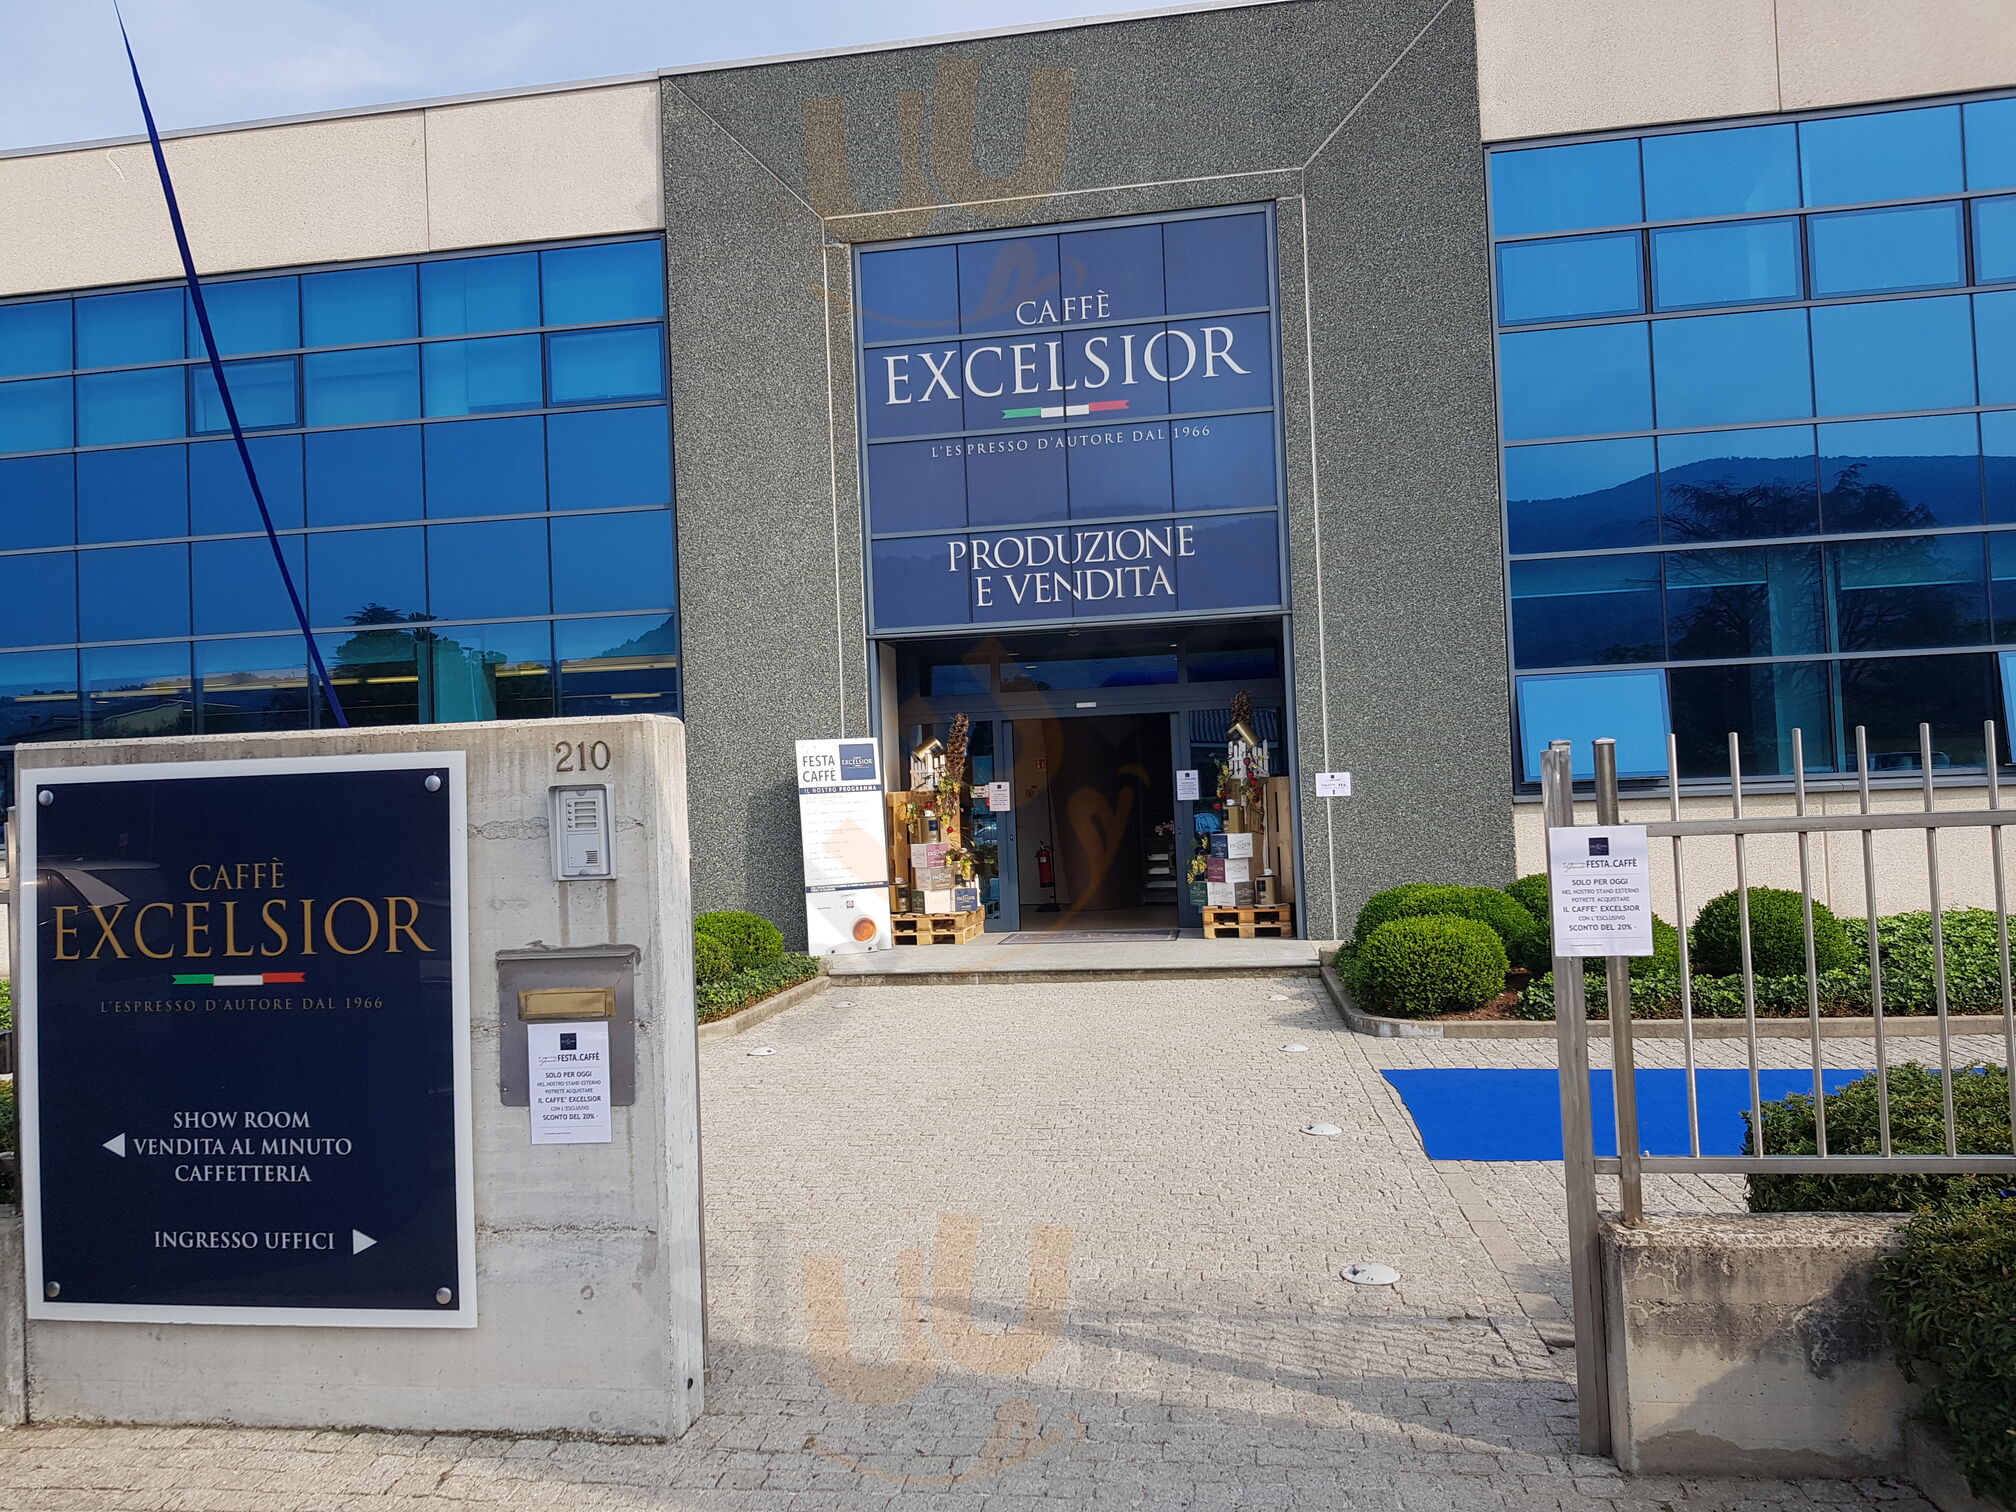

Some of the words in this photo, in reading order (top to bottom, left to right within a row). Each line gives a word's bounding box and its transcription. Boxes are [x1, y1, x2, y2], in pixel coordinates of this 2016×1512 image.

[1016, 290, 1111, 325] CAFFÈ
[882, 326, 1251, 405] EXCELSIOR
[931, 439, 1028, 458] L'ESPRESSO
[1038, 432, 1124, 449] D'AUTORE
[1133, 429, 1165, 442] DAL
[1173, 425, 1211, 439] 1966
[947, 525, 1196, 572] PRODUZIONE
[975, 576, 993, 607] E
[1003, 565, 1175, 605] VENDITA
[555, 740, 611, 772] 210
[802, 755, 835, 767] FESTA
[802, 768, 837, 782] CAFFÈ
[1586, 860, 1610, 869] FESTA
[1613, 857, 1638, 868] CAFFÈ
[189, 857, 285, 892] CAFFÈ
[52, 896, 436, 961] EXCELSIOR
[101, 1000, 197, 1014] L'ESPRESSO
[205, 998, 293, 1012] D'AUTORE
[302, 997, 336, 1011] DAL
[345, 997, 383, 1009] 1966
[557, 1054, 576, 1062] FESTA
[580, 1051, 600, 1061] CAFFÈ
[173, 1111, 238, 1129] SHOW
[244, 1111, 310, 1129] ROOM
[133, 1138, 225, 1155] VENDITA
[231, 1138, 255, 1155] AL
[261, 1138, 352, 1156] MINUTO
[175, 1165, 312, 1182] CAFFETTERIA
[154, 1231, 258, 1249] INGRESSO
[264, 1232, 335, 1250] UFFICI
